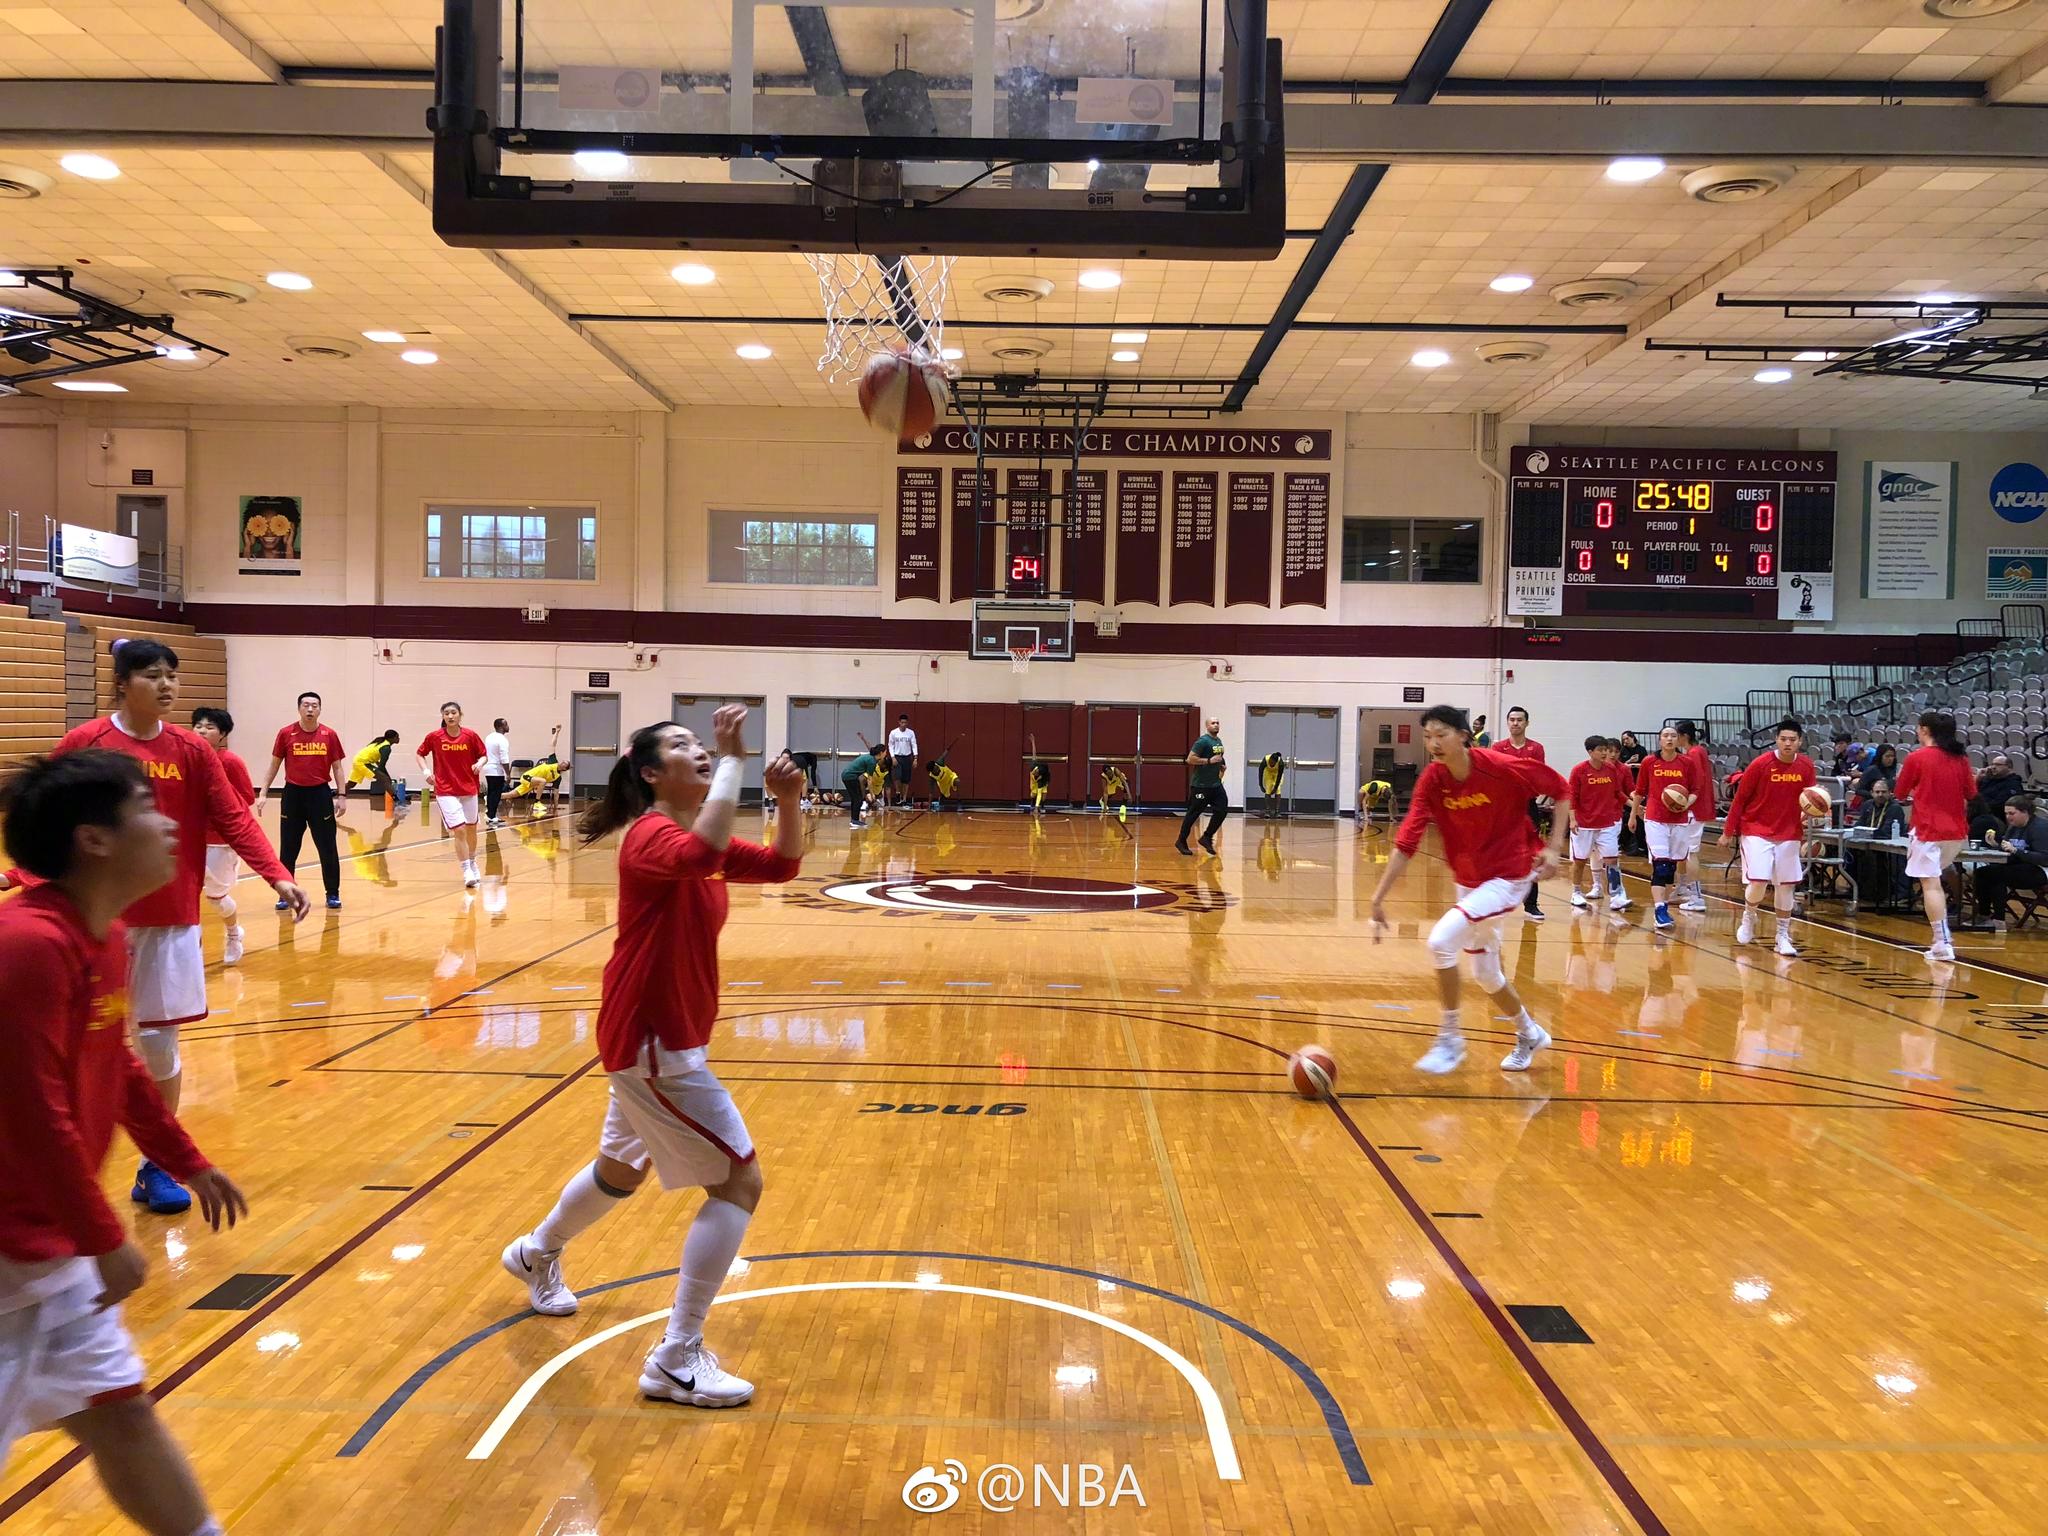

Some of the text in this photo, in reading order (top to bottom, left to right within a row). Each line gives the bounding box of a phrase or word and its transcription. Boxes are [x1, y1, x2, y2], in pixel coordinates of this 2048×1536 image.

[944, 431, 1281, 453] CONFERENCE CHAMPIONS
[1560, 457, 1825, 472] SEATTLE PACIFIC FALCONS
[1584, 486, 1617, 499] HOME
[1882, 482, 1921, 496] gnac
[1637, 483, 1710, 510] 25:48
[1736, 489, 1771, 501] GUEST
[1995, 492, 2048, 507] NCAA
[1597, 503, 1612, 528] 0
[1756, 505, 1772, 531] 0
[1646, 521, 1678, 531] PERIOD
[1689, 518, 1695, 535] 1
[1571, 540, 1594, 550] FOULS
[1611, 541, 1634, 550] T.O.L.
[1643, 542, 1701, 551] PLAYER FOUL
[1710, 543, 1733, 552] T.O.L.
[1750, 544, 1773, 553] FOULS
[1579, 552, 1591, 570] 0
[1616, 553, 1629, 570] 4
[1715, 555, 1728, 572] 4
[1758, 555, 1770, 574] 0
[1012, 559, 1038, 580] 24
[1516, 571, 1556, 580] SEATTLE
[1567, 573, 1596, 583] SCORE
[1656, 575, 1686, 584] MATCH
[1745, 577, 1775, 586] SCORE
[1516, 586, 1555, 596] PRINTING
[531, 610, 542, 619] EXIT
[1102, 621, 1114, 630] EXIT
[293, 742, 327, 750] CHINA
[441, 743, 468, 751] CHINA
[143, 760, 182, 781] INA
[1654, 769, 1682, 777] CHINA
[1588, 776, 1612, 785] CHINA
[1771, 774, 1802, 782] CHINA
[857, 1102, 1028, 1116] gnac
